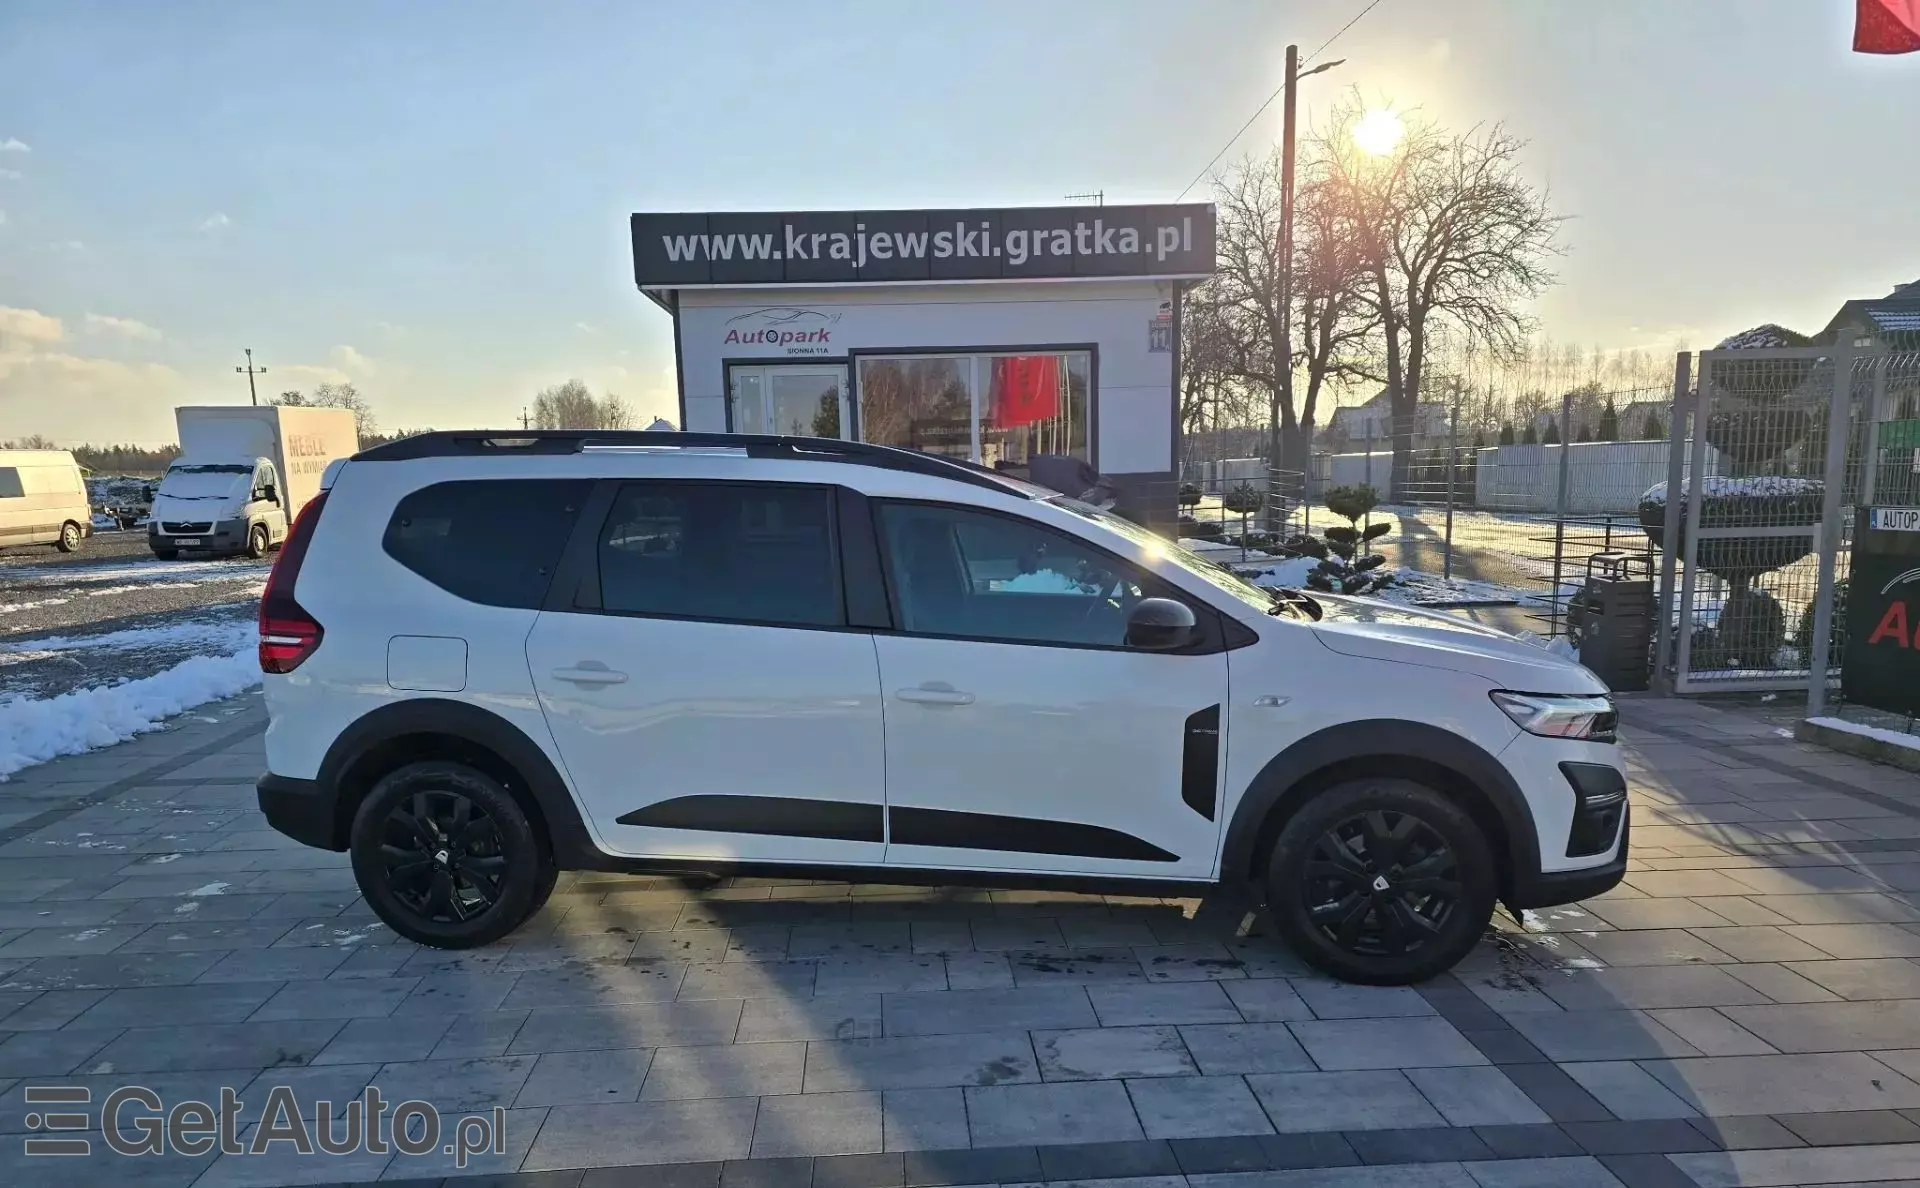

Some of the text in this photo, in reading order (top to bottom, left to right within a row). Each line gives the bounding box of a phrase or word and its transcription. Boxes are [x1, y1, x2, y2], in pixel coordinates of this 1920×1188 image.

[662, 218, 1193, 268] www.krajewski.gratka.pl
[724, 328, 831, 347] Autopark
[787, 347, 815, 355] SIONNA
[1883, 510, 1920, 529] AUTOP
[1868, 600, 1920, 650] A
